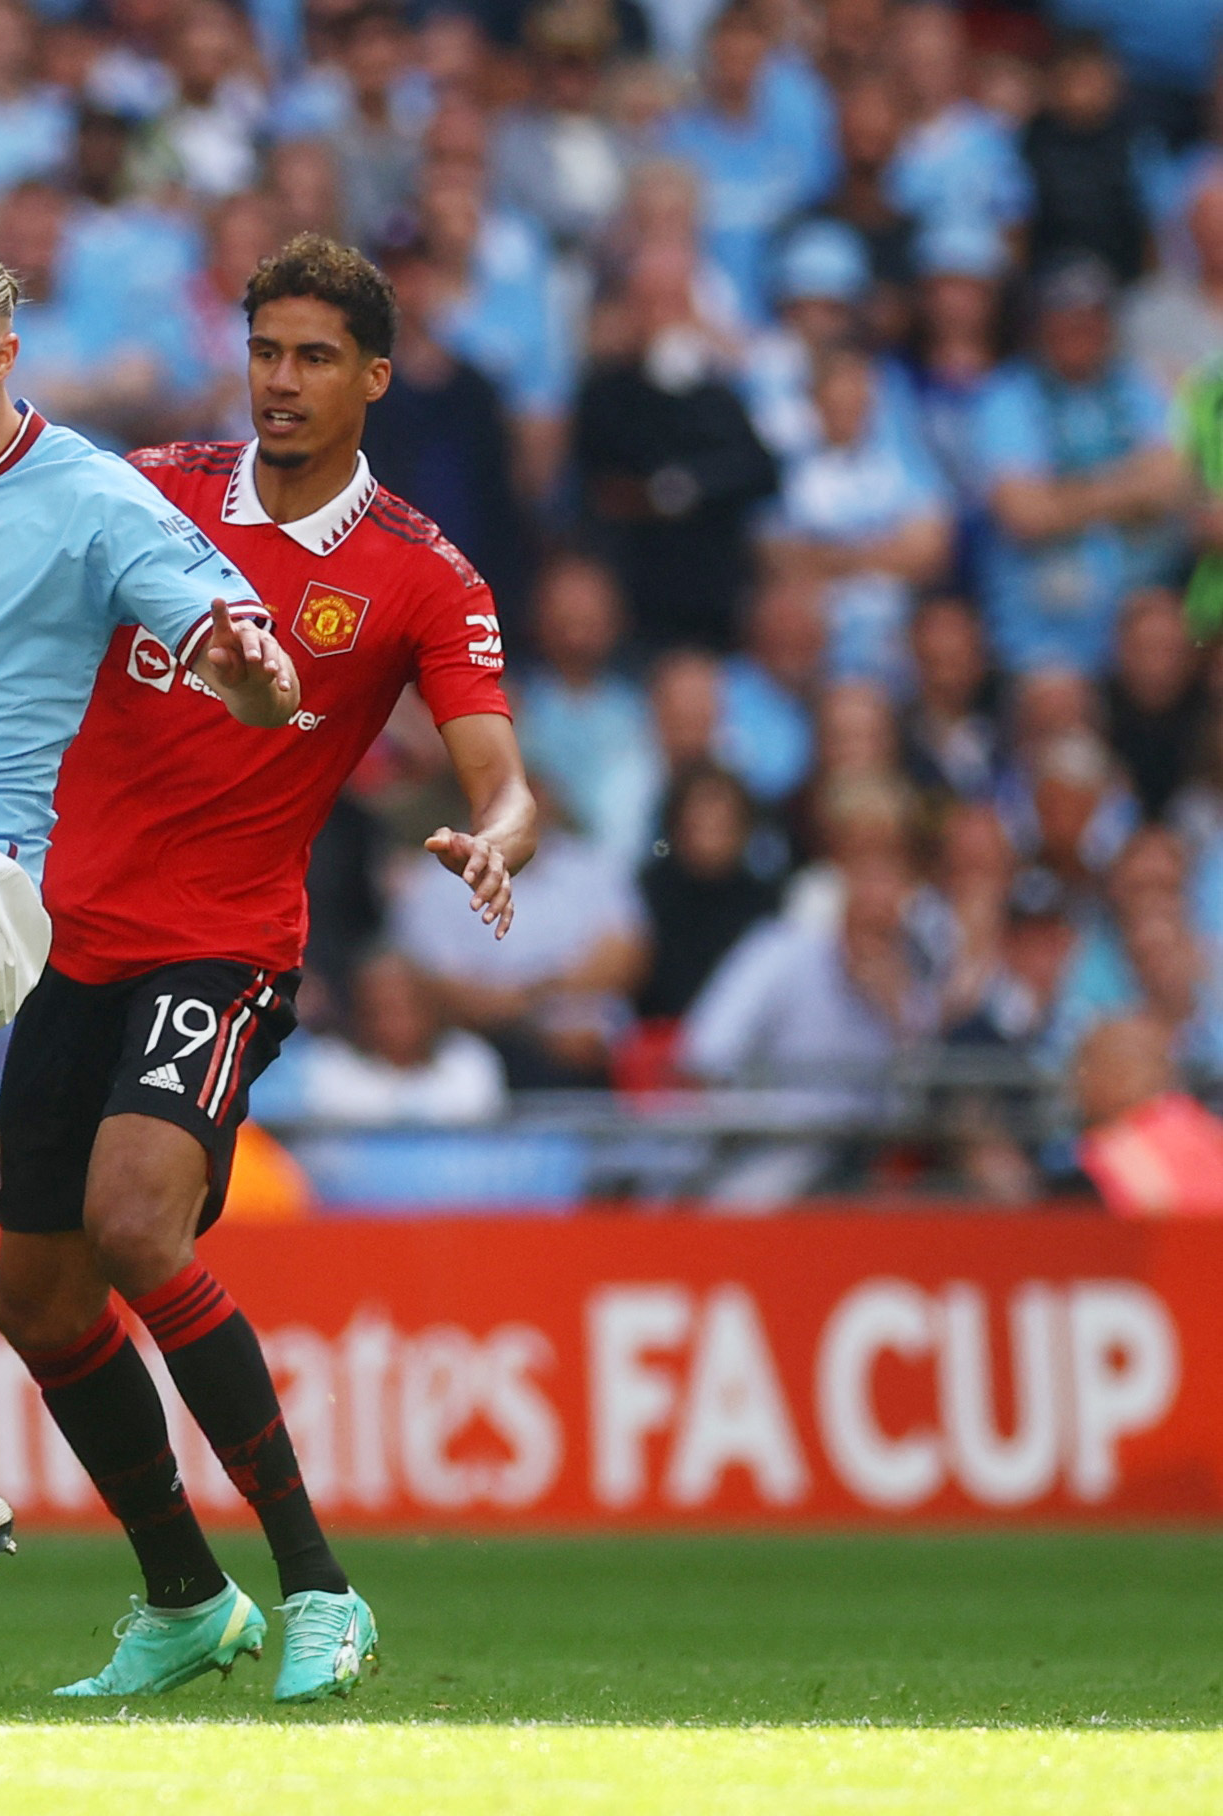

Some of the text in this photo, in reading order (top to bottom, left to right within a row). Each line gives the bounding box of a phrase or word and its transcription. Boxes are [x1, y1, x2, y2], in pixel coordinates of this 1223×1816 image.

[144, 994, 218, 1060] 19
[138, 1074, 186, 1095] adidas
[586, 1282, 810, 1508] FA
[814, 1275, 1182, 1508] CUP
